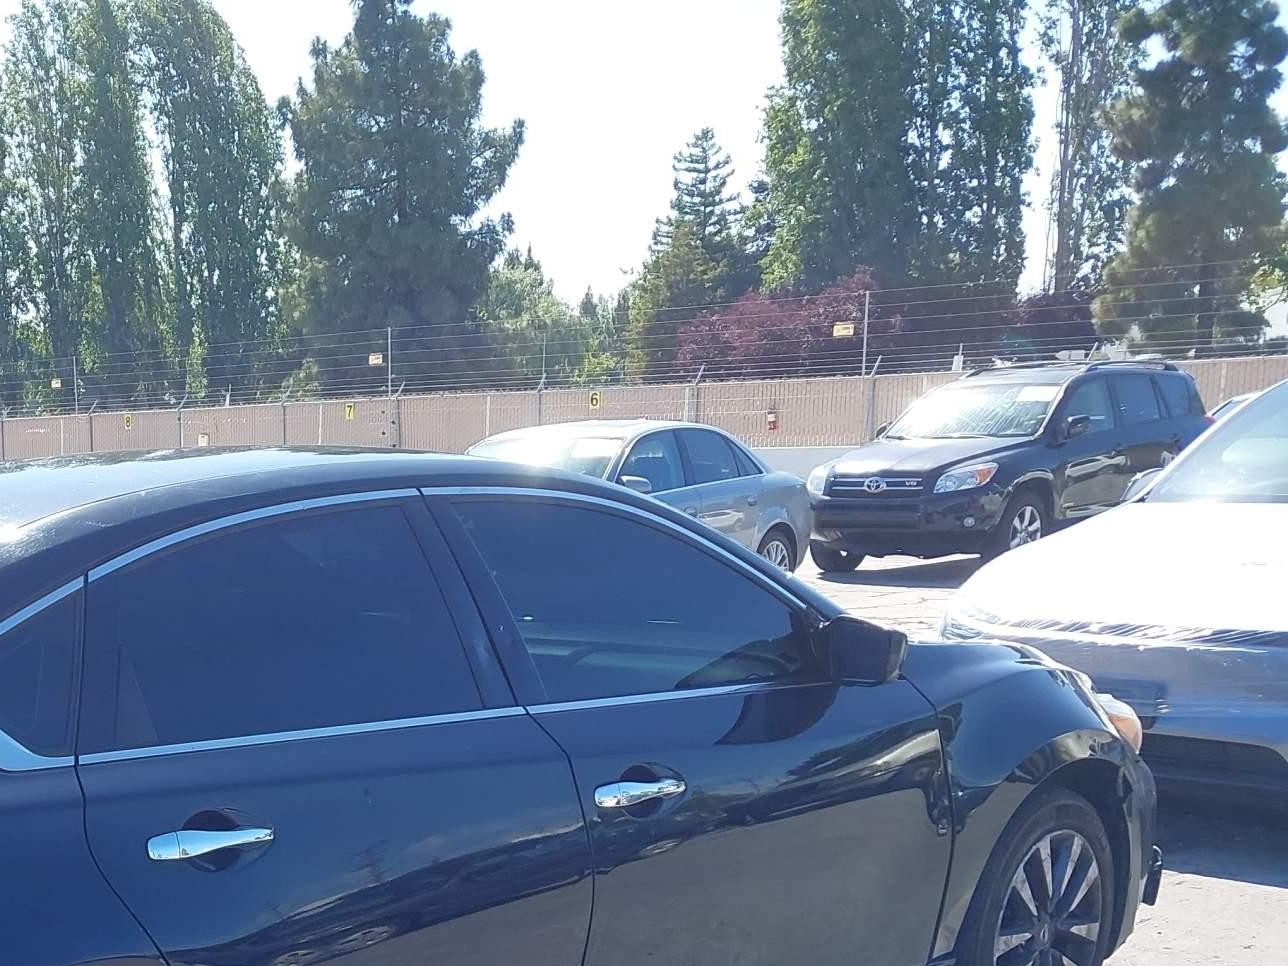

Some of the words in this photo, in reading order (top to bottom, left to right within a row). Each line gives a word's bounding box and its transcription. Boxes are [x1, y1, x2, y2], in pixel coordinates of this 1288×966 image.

[590, 392, 599, 407] 6
[347, 404, 353, 418] 7
[125, 415, 131, 428] 8
